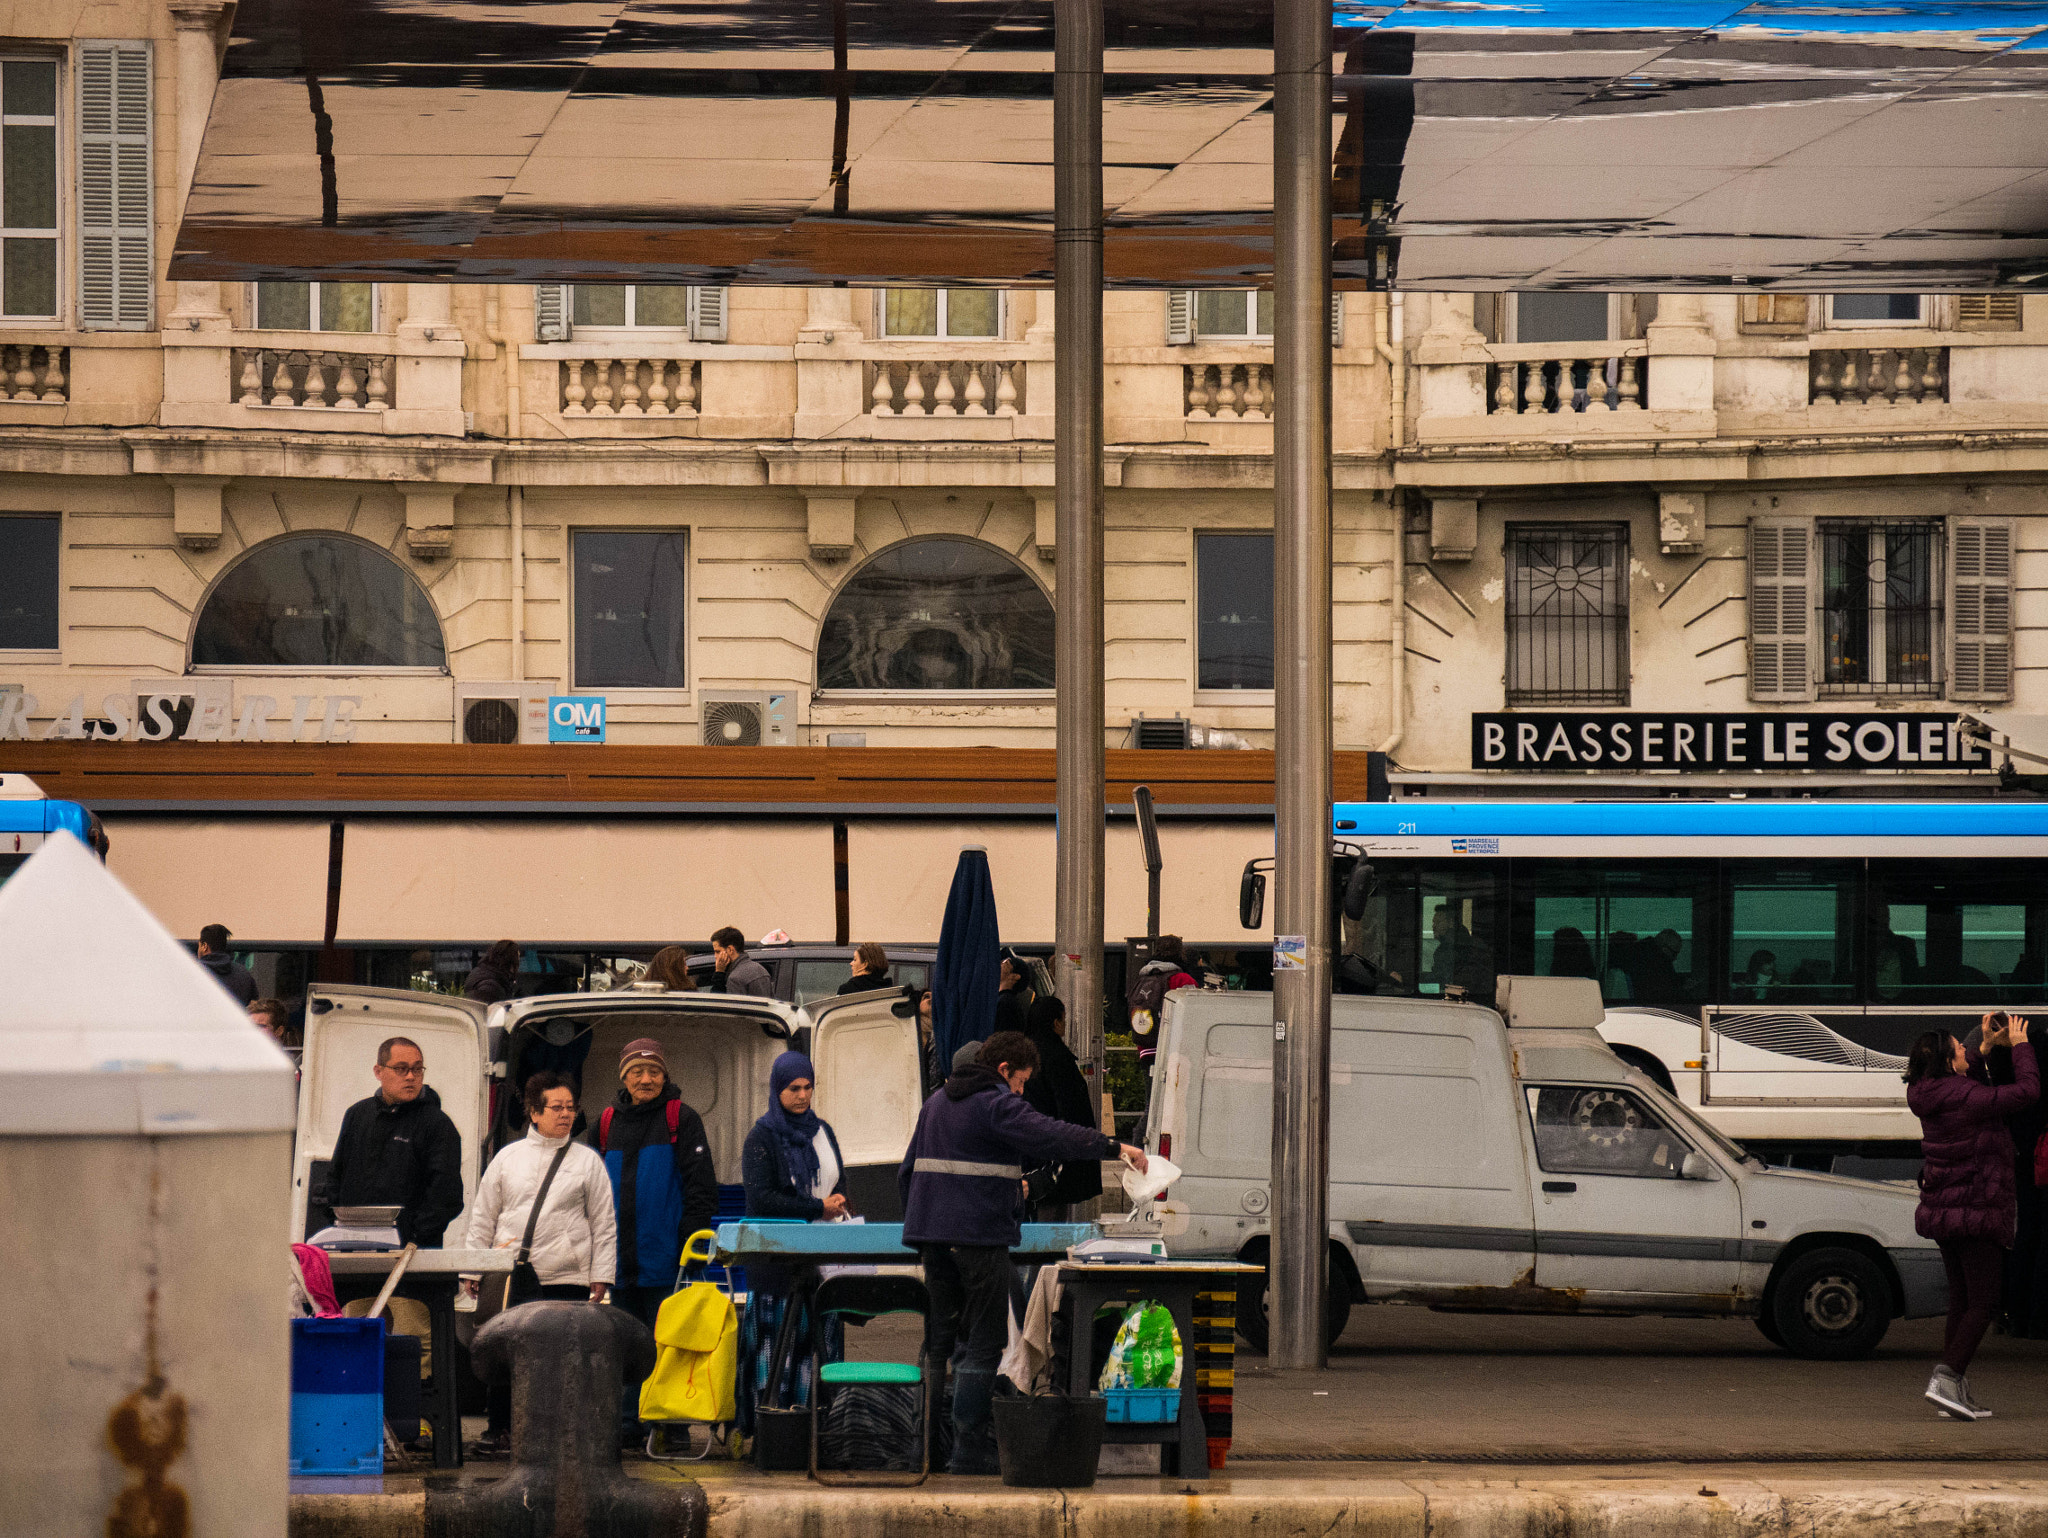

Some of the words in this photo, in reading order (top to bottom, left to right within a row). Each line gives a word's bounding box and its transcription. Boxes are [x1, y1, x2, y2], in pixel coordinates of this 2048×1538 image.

[554, 703, 601, 726] OM
[1482, 722, 1748, 762] BRASSERIE
[1763, 722, 1810, 762] LE
[1398, 822, 1416, 834] 211
